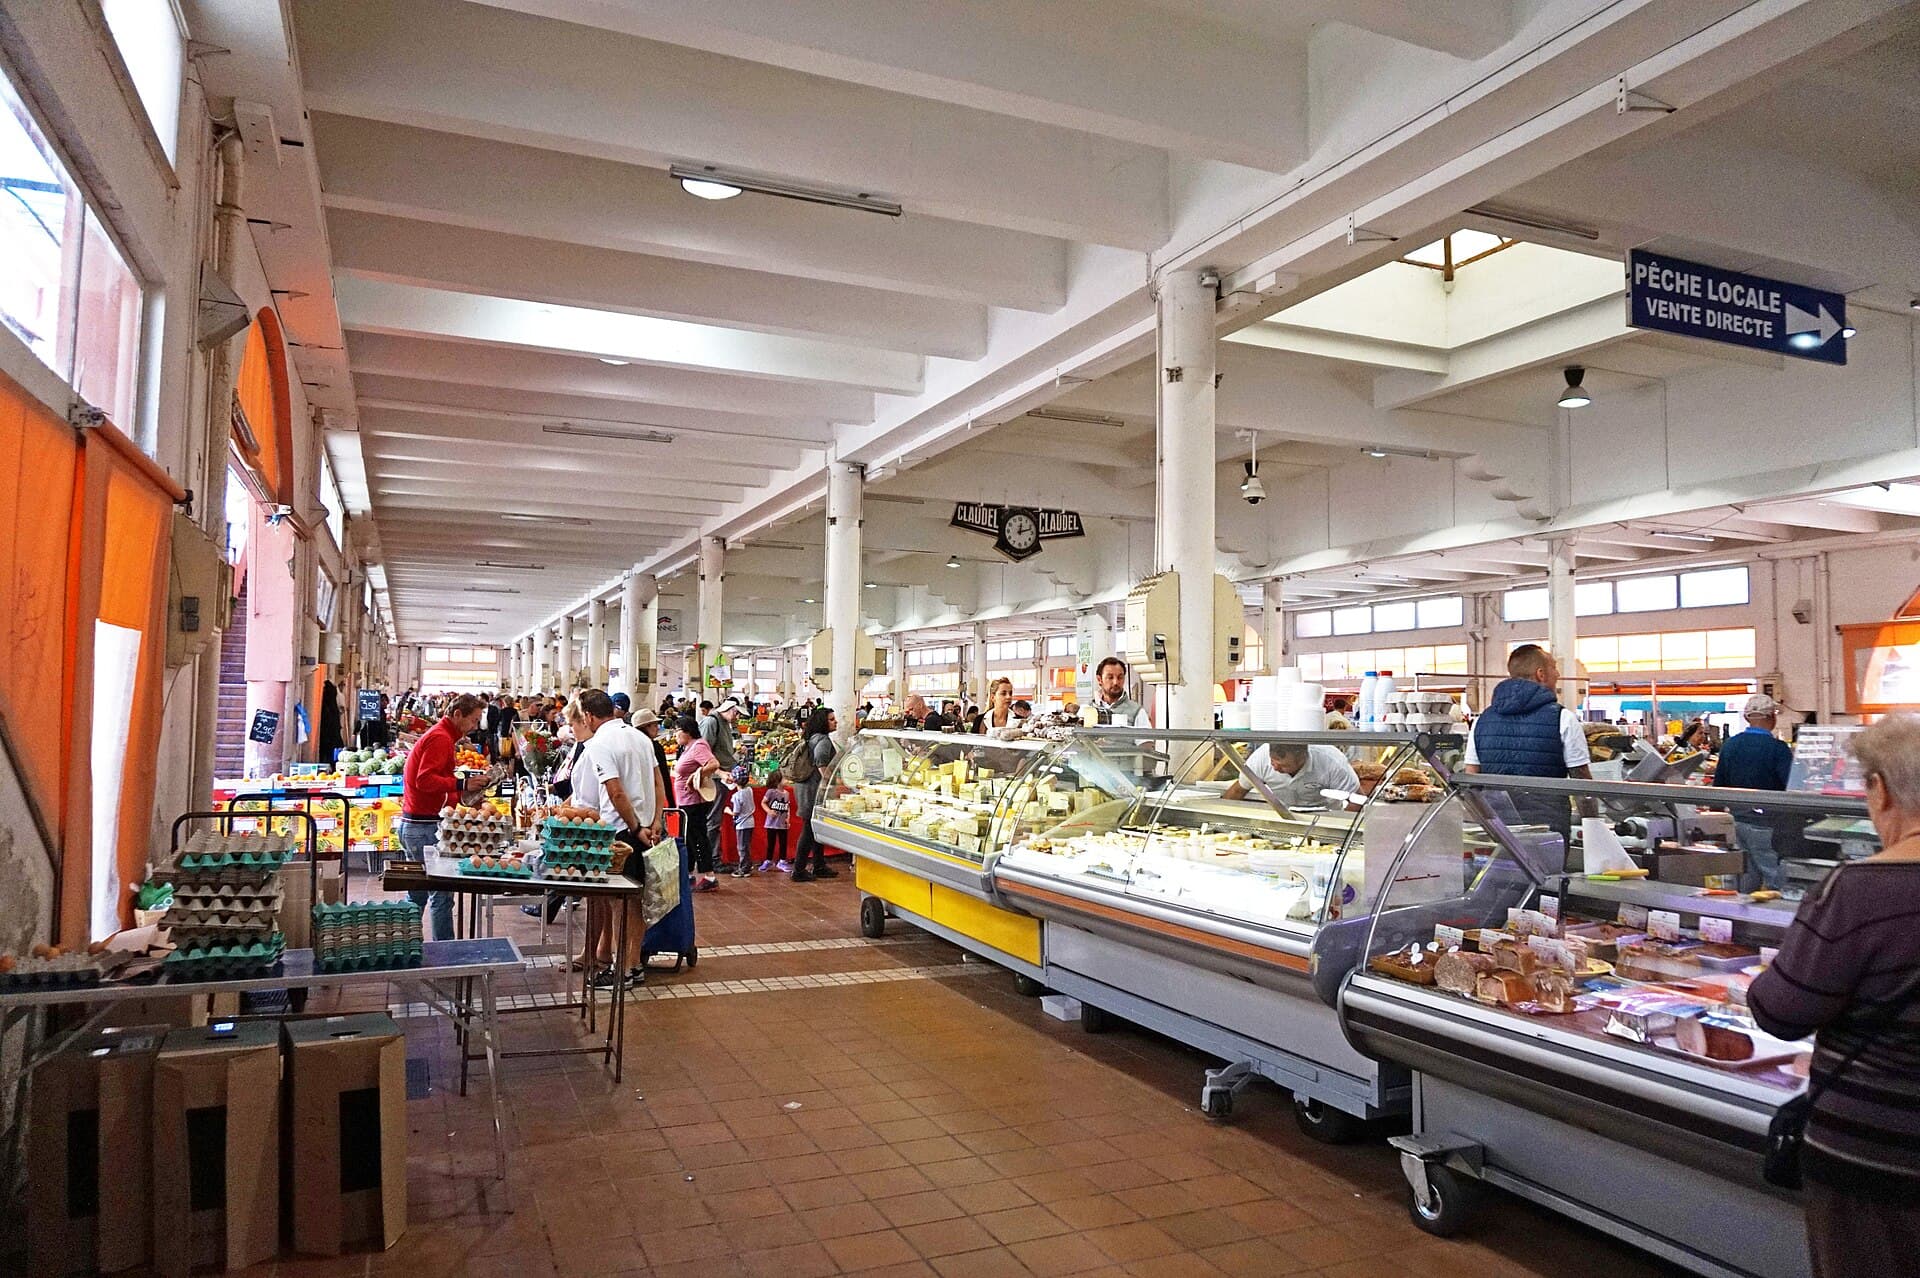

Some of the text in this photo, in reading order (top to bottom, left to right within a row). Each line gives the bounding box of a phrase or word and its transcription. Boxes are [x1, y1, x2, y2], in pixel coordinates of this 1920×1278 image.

[1635, 262, 1782, 314] PÊCHE LOCALE
[1646, 297, 1773, 338] VENTE DIRECTE
[958, 505, 999, 528] CLAUDEL
[1039, 512, 1079, 533] CLAUDEL
